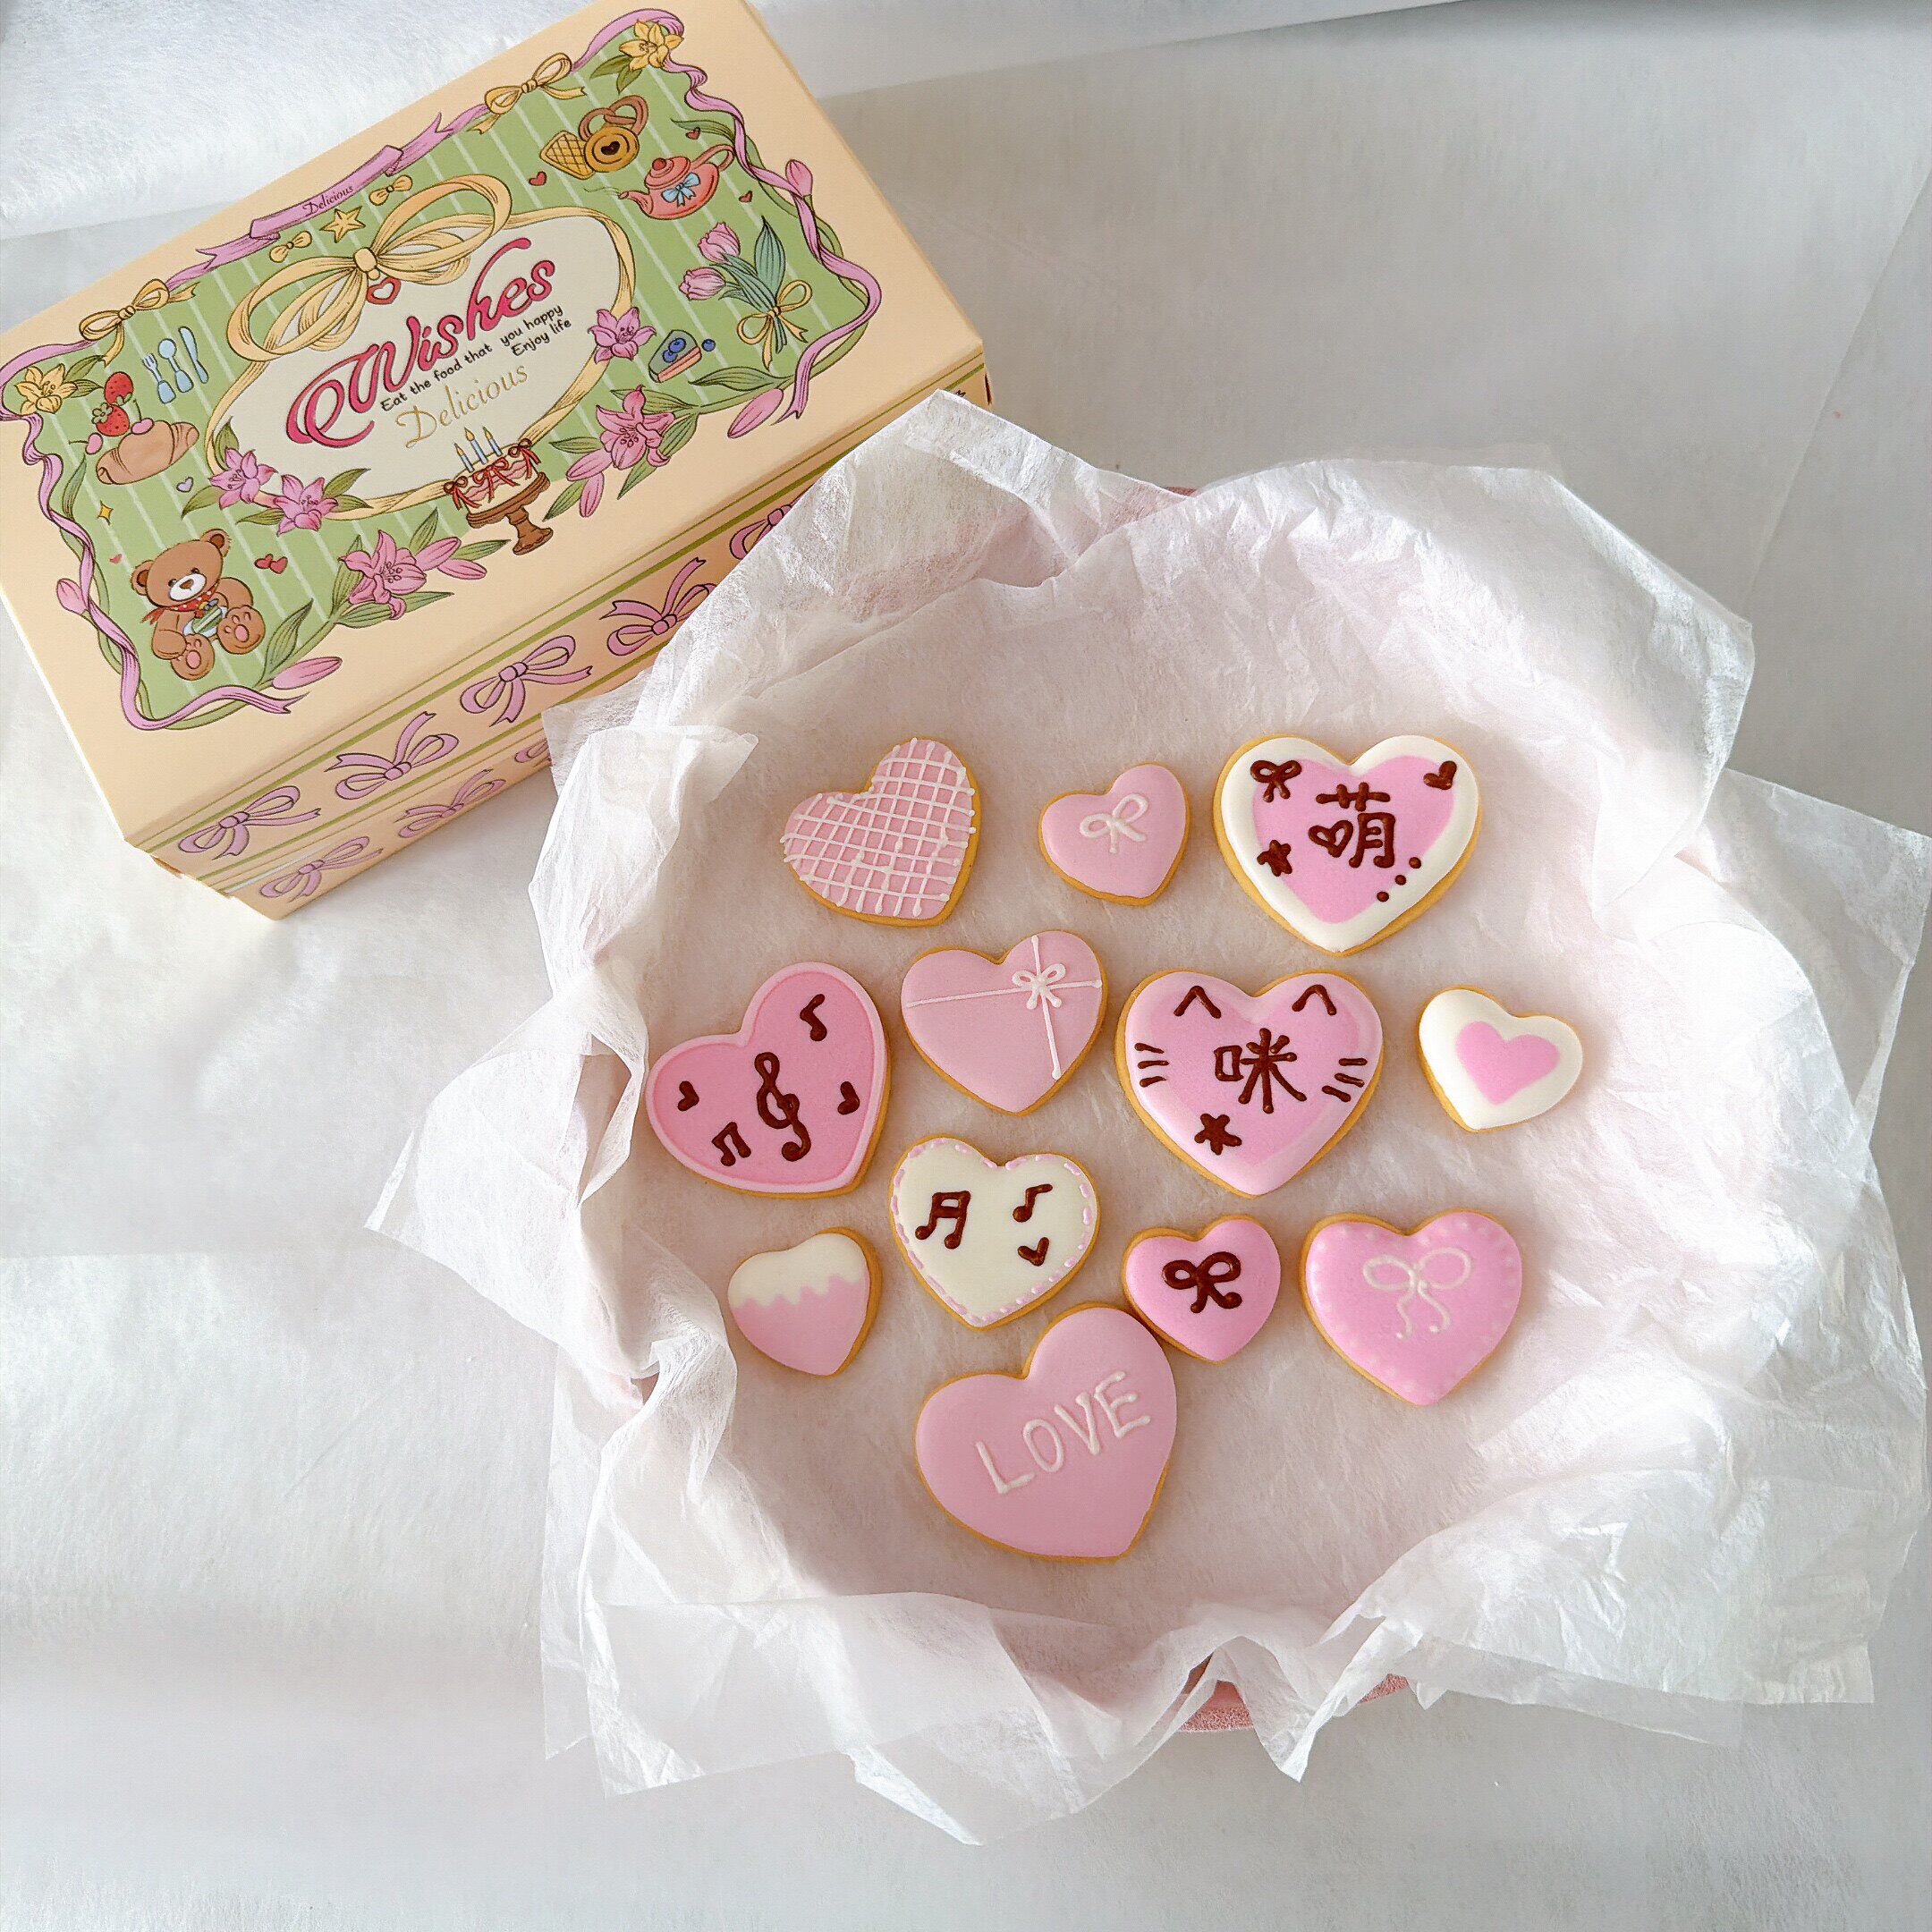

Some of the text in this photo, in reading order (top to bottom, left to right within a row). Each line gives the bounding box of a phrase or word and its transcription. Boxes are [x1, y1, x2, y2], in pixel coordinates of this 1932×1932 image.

[302, 184, 354, 217] Delicious
[285, 237, 555, 447] Wishes
[380, 304, 564, 412] Eat the food that you happy
[511, 318, 572, 357] Enjoy life
[395, 364, 529, 448] Delicious
[1308, 781, 1396, 869] 萌
[1214, 1028, 1308, 1114] 咪
[975, 1370, 1151, 1495] LOVE
